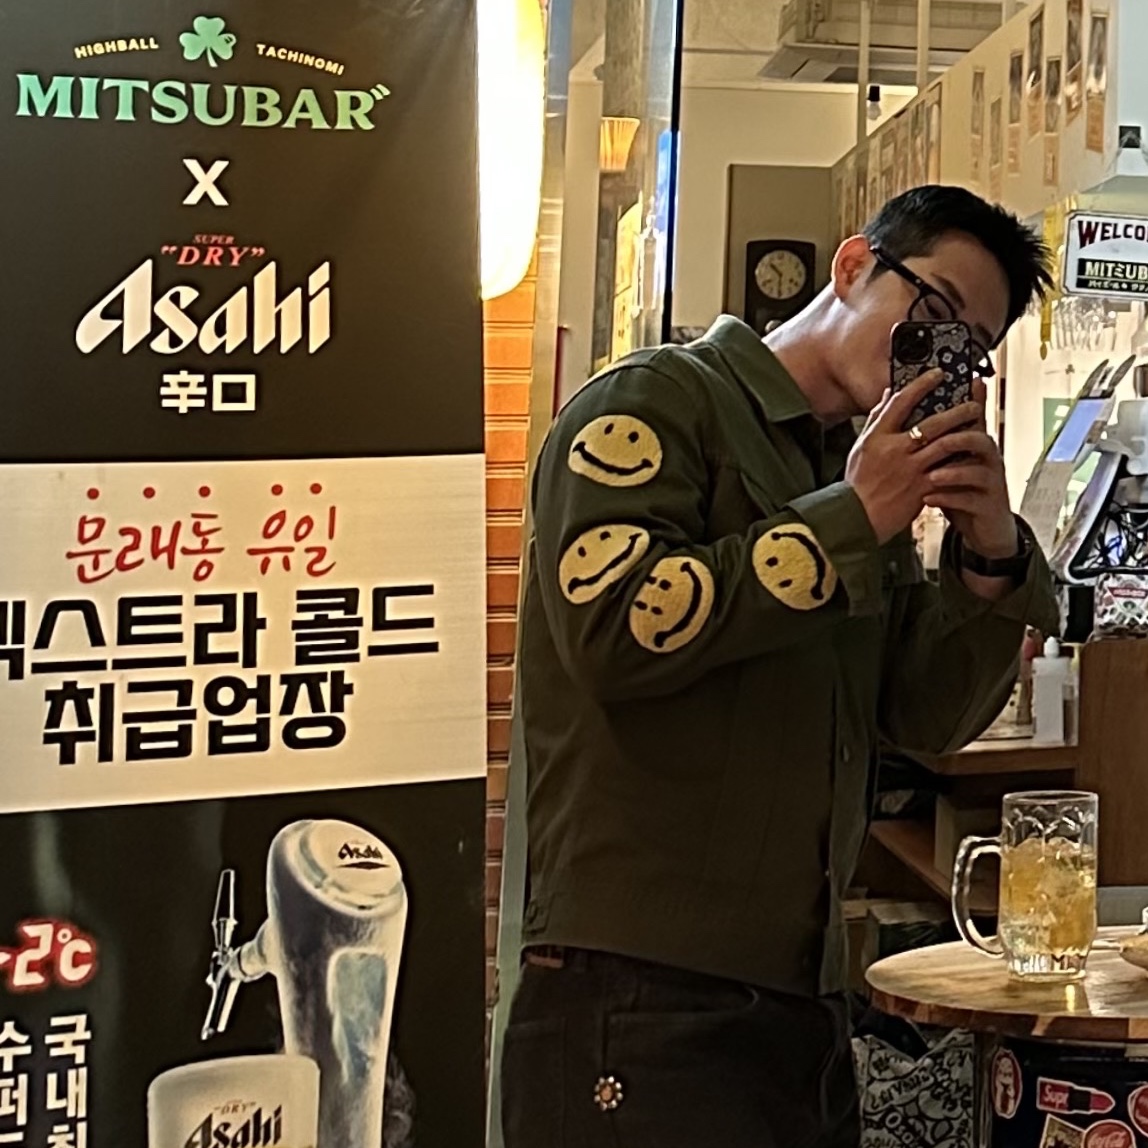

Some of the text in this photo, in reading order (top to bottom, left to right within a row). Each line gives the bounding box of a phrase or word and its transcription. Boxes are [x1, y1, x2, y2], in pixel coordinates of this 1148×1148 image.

[74, 37, 160, 59] HIGHBALL
[256, 43, 345, 76] TACHINOMI
[182, 158, 229, 206] X
[194, 234, 236, 245] SUPER
[75, 259, 330, 355] Asahi
[160, 371, 256, 413] 辛口
[66, 506, 337, 584] 문래동 유일
[292, 585, 440, 666] 콜드
[43, 670, 354, 765] 취급업장
